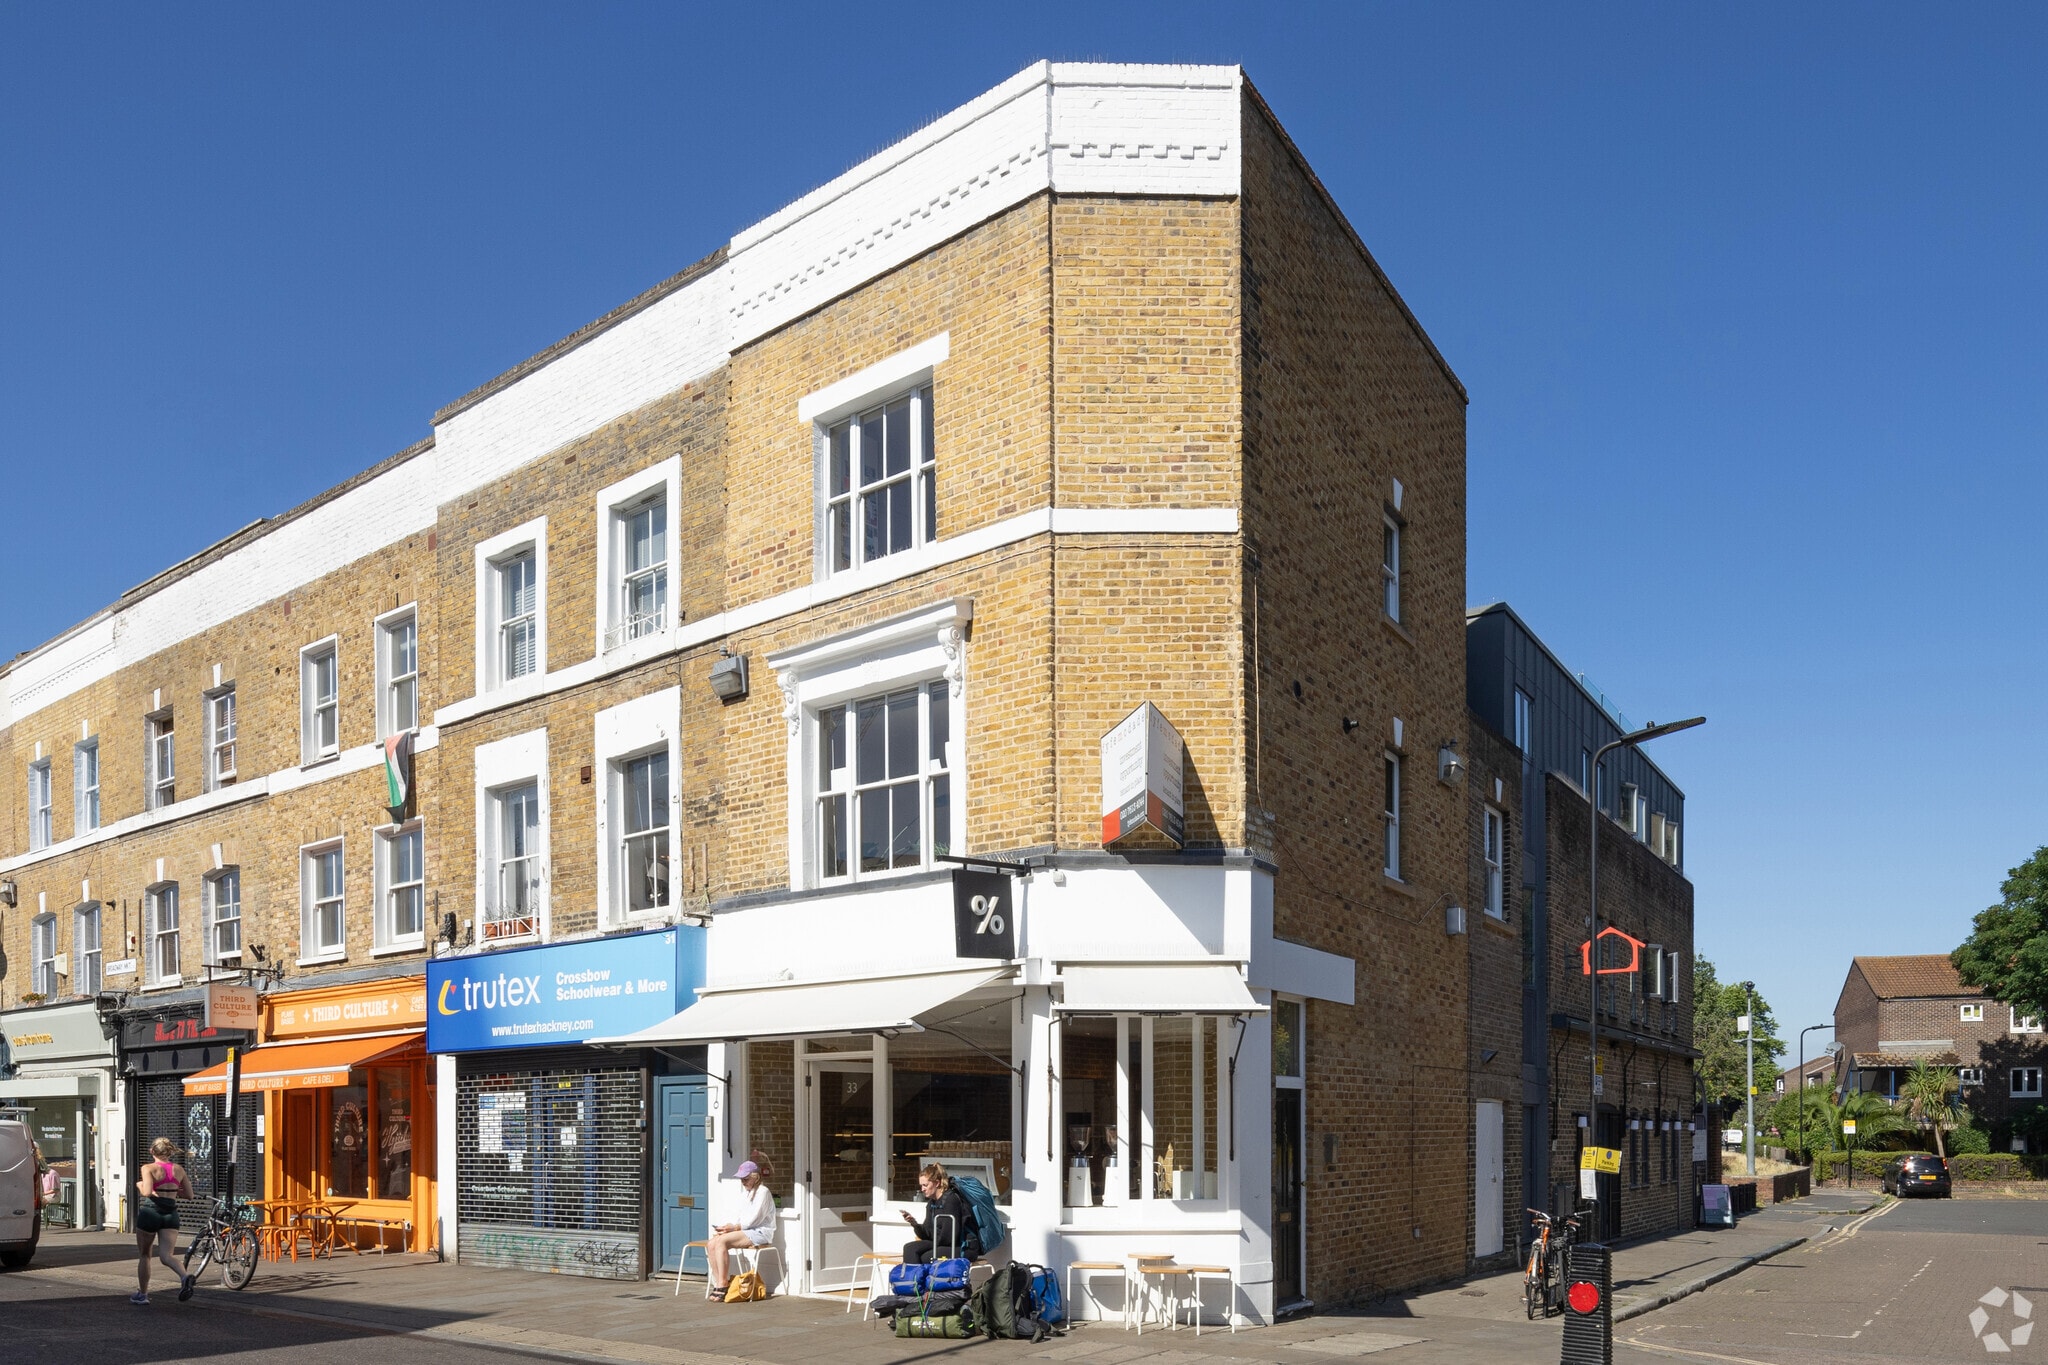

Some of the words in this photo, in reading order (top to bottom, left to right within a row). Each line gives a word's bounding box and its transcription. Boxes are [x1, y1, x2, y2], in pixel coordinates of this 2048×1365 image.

[665, 933, 676, 945] 31
[556, 969, 610, 985] Crossbow
[463, 973, 541, 1011] trutex
[556, 983, 622, 1001] Schoolwear
[625, 981, 634, 995] &
[637, 978, 667, 994] More
[219, 995, 246, 1003] THIRD
[411, 996, 425, 1005] CAFE
[312, 1005, 341, 1022] THIRD
[343, 1000, 389, 1020] CULTURE
[492, 1019, 594, 1037] www.trutexhackney.com
[193, 1084, 207, 1092] PLANT
[208, 1083, 223, 1091] BASED
[257, 1078, 284, 1089] CULTURE
[302, 1076, 316, 1085] CAFE
[322, 1075, 335, 1084] DELI
[847, 1082, 858, 1094] 33
